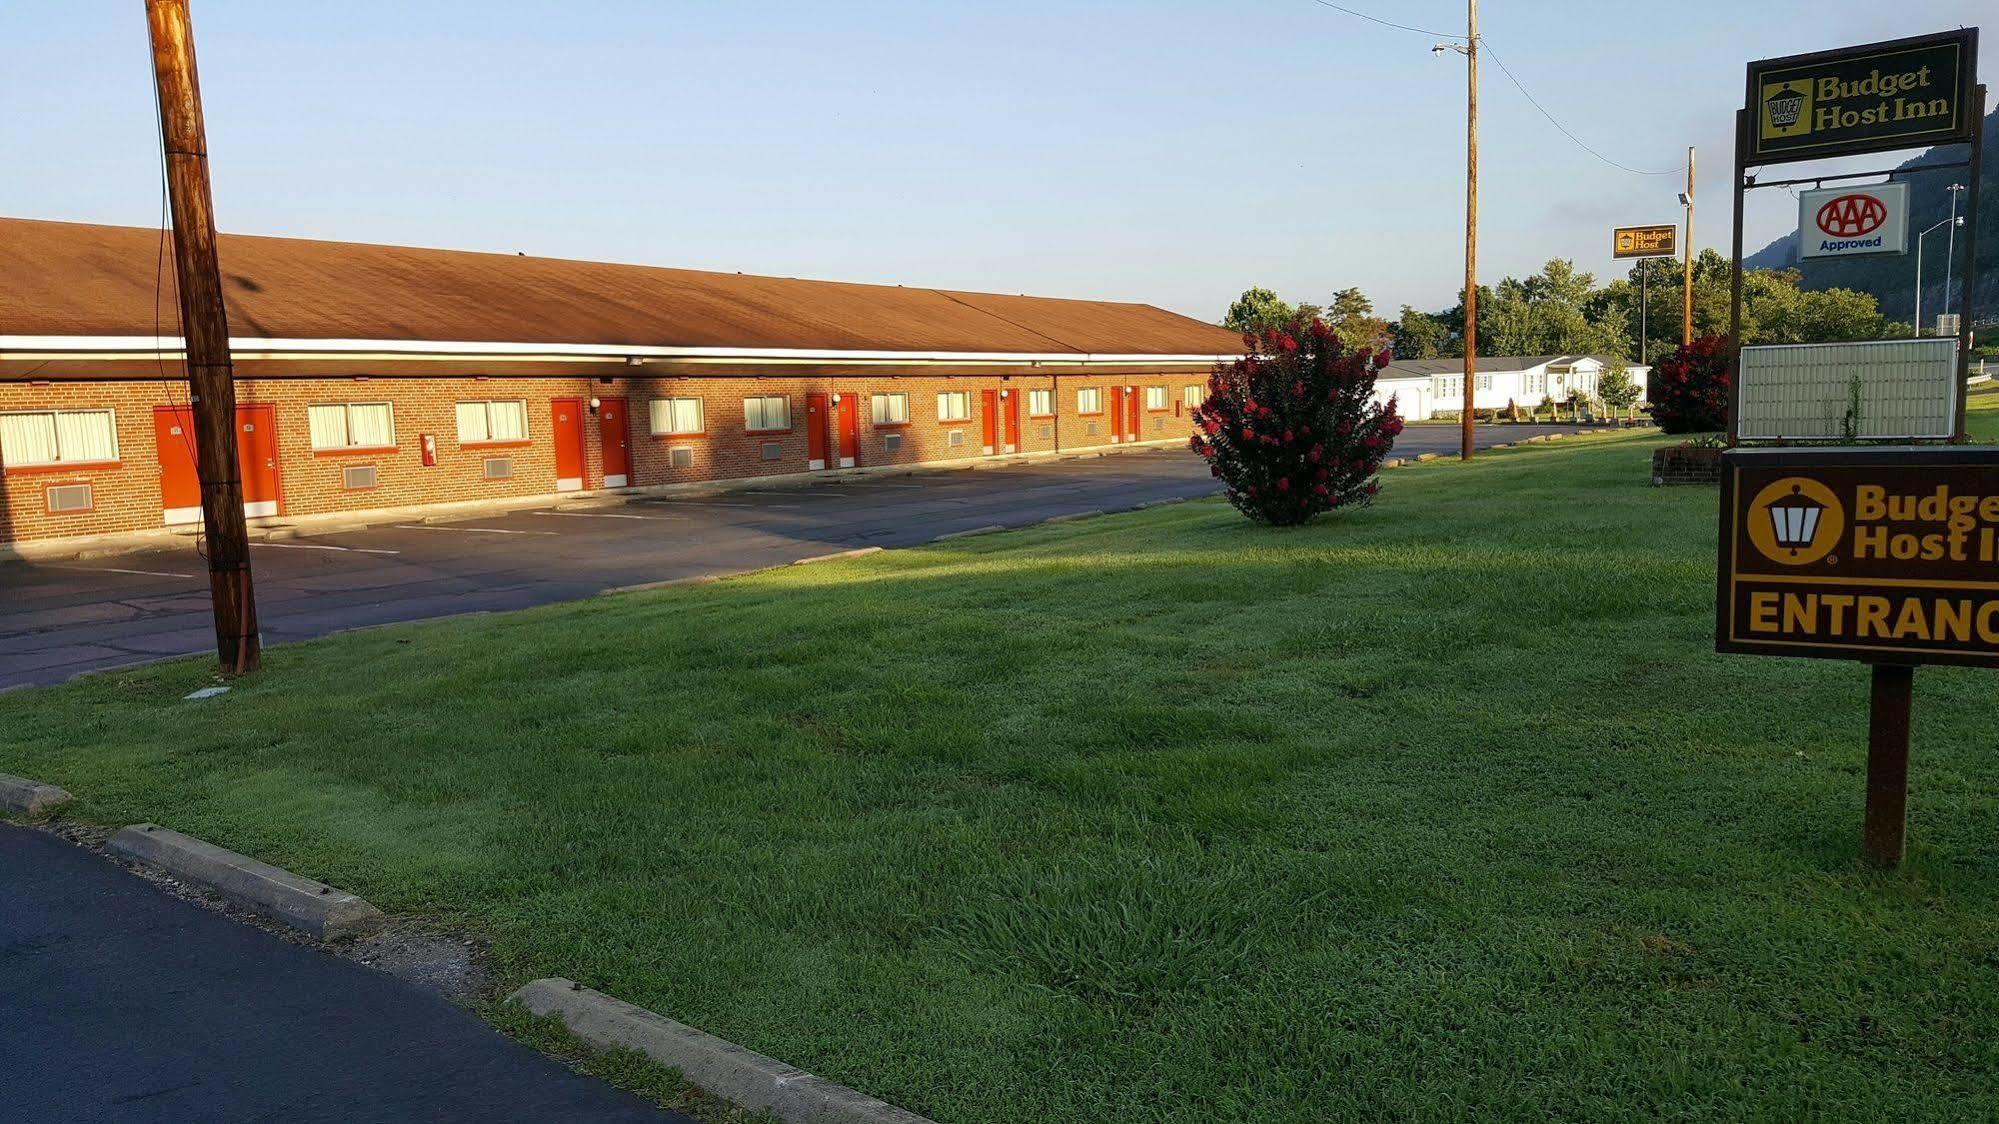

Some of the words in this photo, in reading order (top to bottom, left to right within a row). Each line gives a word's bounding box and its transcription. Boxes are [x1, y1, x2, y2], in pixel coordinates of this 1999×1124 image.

[1816, 65, 1931, 102] Budget
[1815, 101, 1889, 131] Host
[1893, 97, 1949, 121] Inn
[1821, 195, 1882, 237] AAA
[1634, 240, 1659, 249] Host
[1635, 231, 1672, 241] Budget
[1820, 236, 1882, 251] Approved
[1854, 526, 1968, 561] Host
[1980, 528, 1999, 562] I
[1750, 591, 1999, 644] ENTRANC
